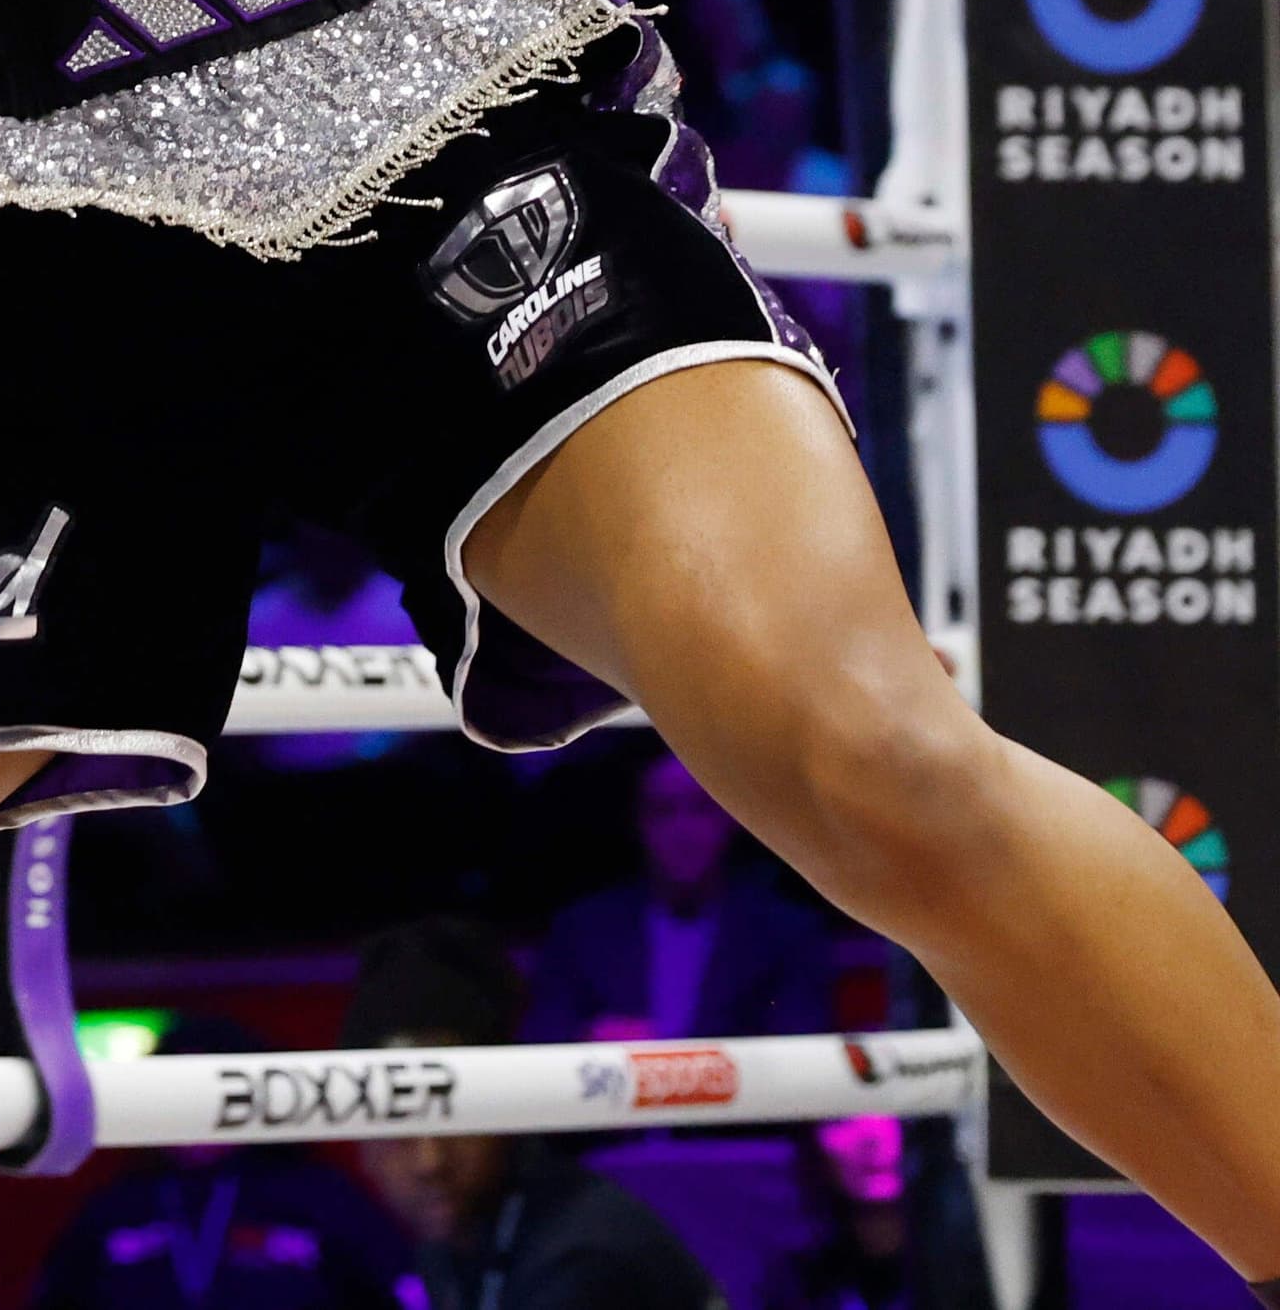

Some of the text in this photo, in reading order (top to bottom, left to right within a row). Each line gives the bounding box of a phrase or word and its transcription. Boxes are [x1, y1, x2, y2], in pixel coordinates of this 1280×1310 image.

[996, 84, 1245, 132] RIYADH
[996, 135, 1246, 182] SEASON
[487, 255, 602, 367] CAROLINE
[1005, 528, 1256, 573] RIYADH
[1005, 577, 1257, 624] SEASON
[215, 1062, 456, 1129] BOXXER
